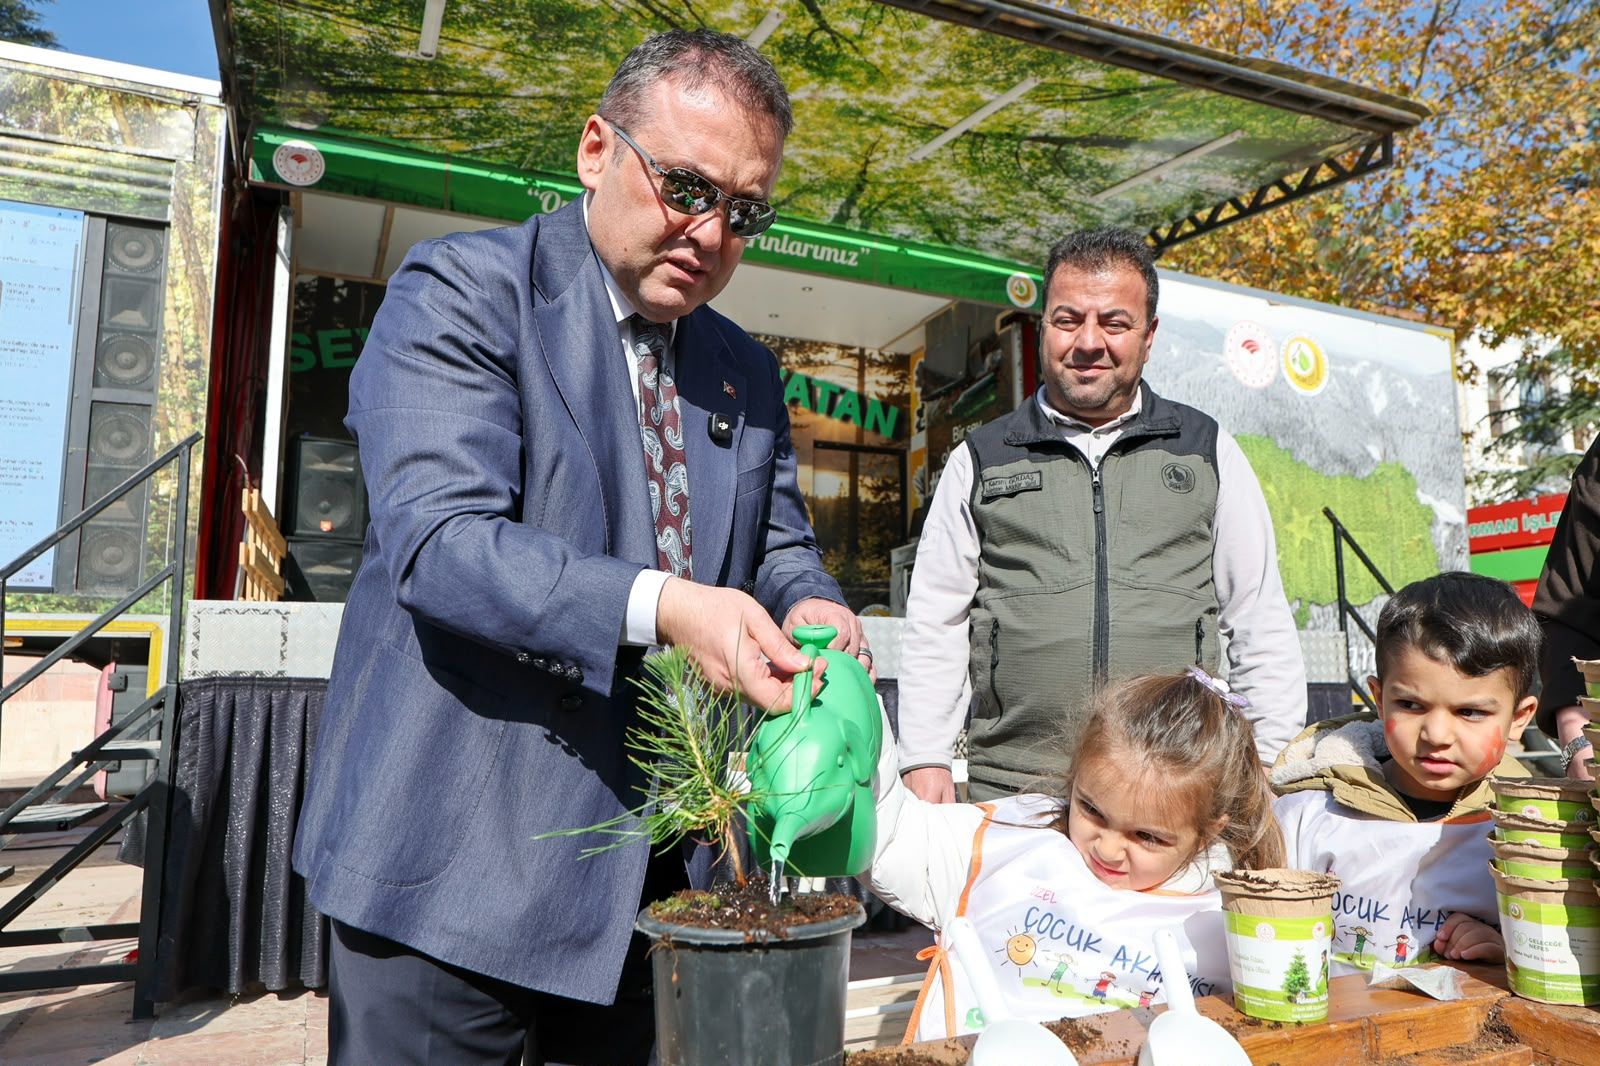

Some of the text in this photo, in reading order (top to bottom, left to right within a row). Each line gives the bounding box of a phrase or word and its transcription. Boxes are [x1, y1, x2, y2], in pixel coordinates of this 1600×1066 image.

[527, 188, 569, 214] “O
[780, 367, 898, 439] ATAN
[1469, 511, 1562, 538] RMAN İŞLE
[1331, 890, 1390, 923] OCUK
[1023, 906, 1102, 953] ÇOCUK
